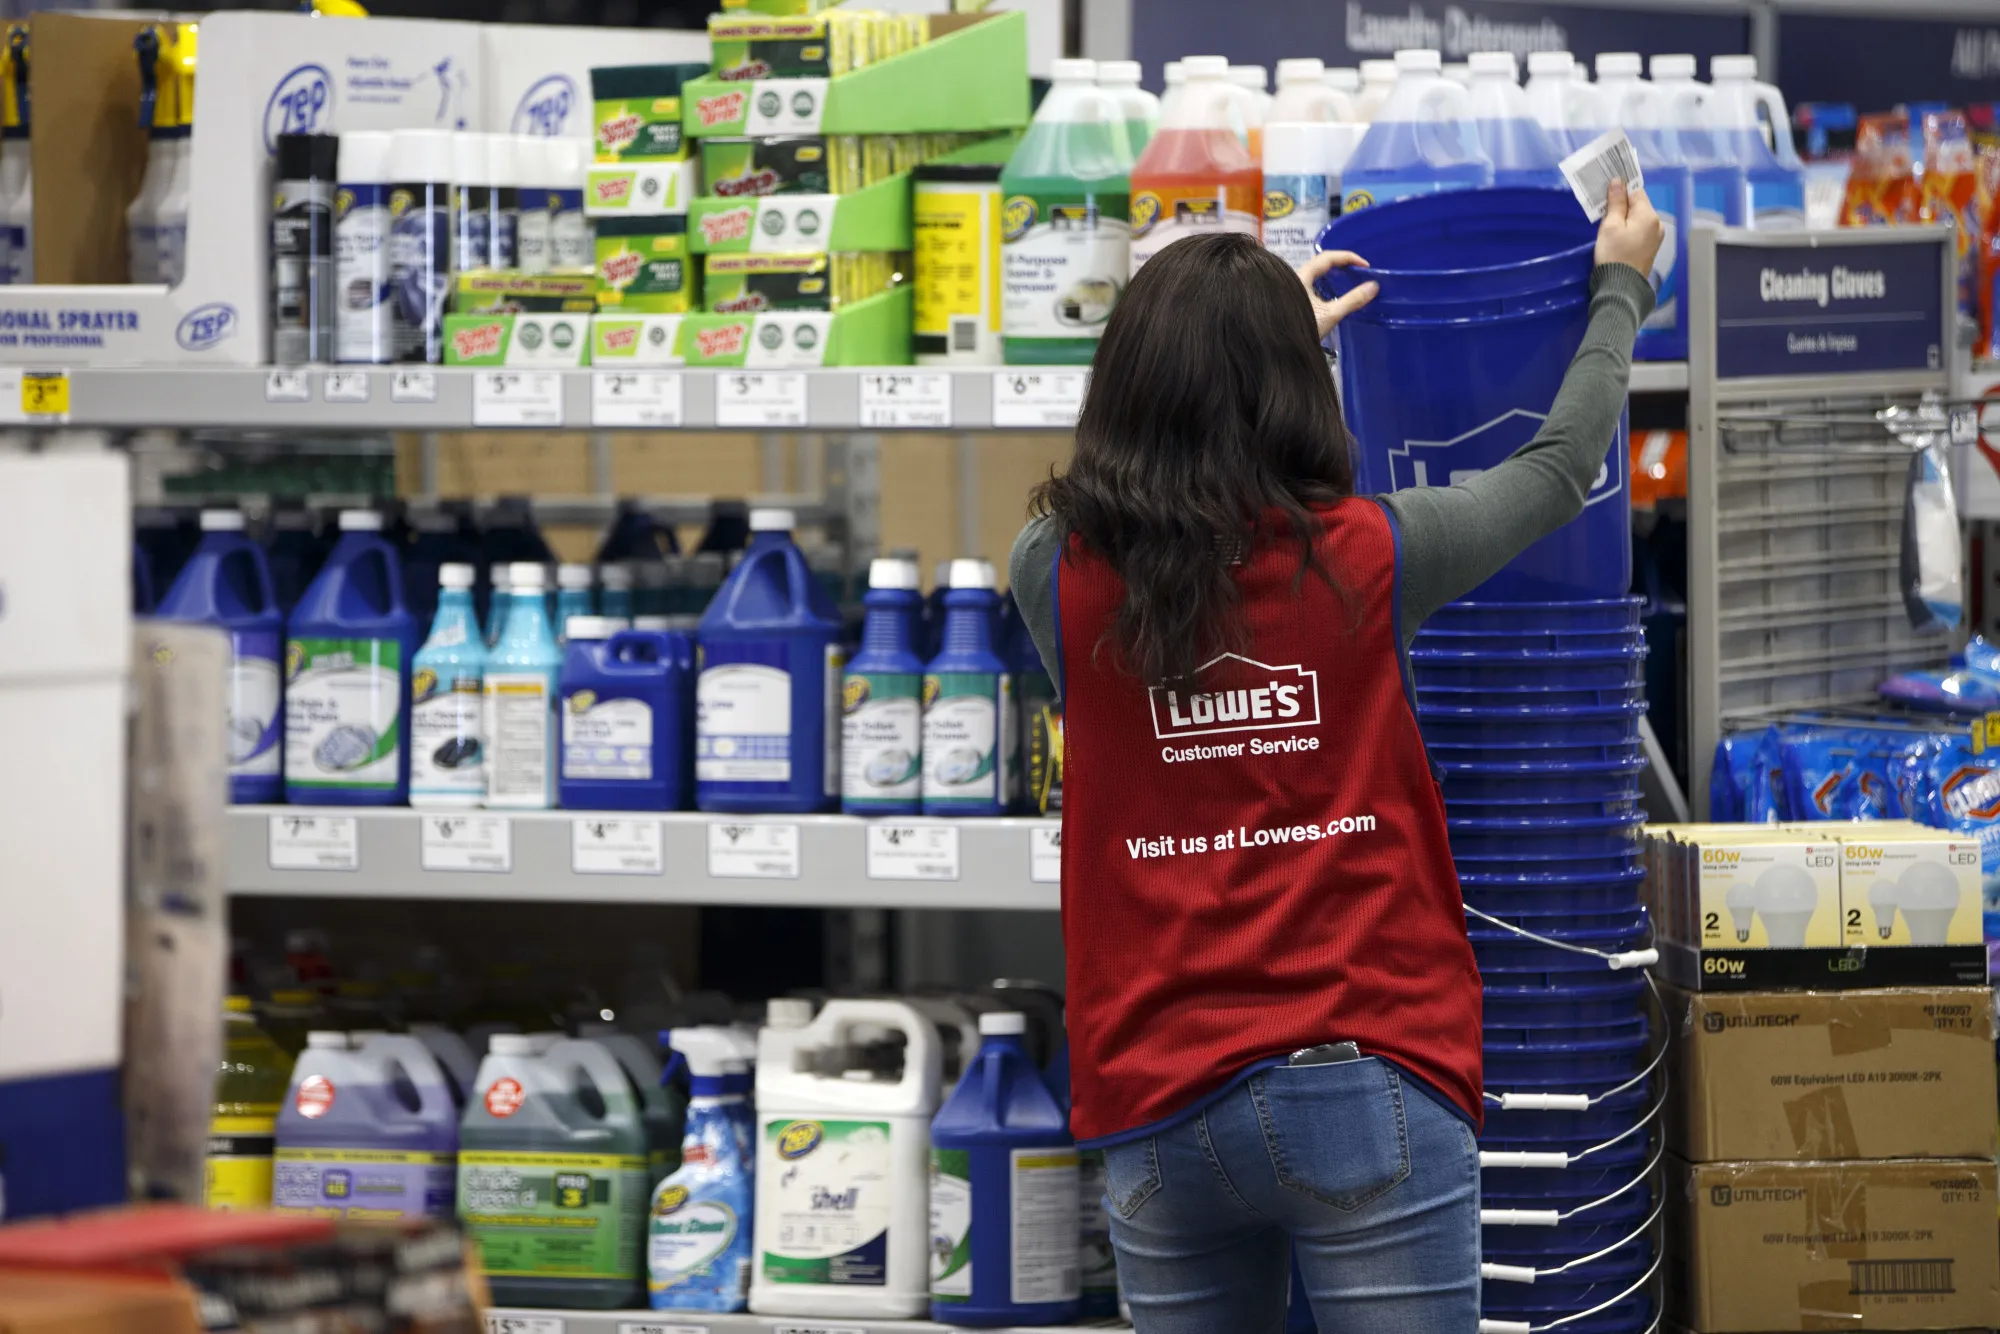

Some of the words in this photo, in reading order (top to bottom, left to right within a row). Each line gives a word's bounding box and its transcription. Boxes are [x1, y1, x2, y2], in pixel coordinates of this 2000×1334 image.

[1760, 266, 1829, 307] Cleaning
[1831, 264, 1885, 299] Gloves
[58, 309, 139, 331] SPRAYER
[189, 311, 232, 342] ZEP
[1162, 743, 1246, 763] Customer
[1250, 735, 1320, 756] Service
[1127, 836, 1175, 860] Visit
[1181, 837, 1208, 855] us
[1213, 830, 1235, 851] at
[1240, 814, 1376, 848] Lowes.com
[1703, 848, 1741, 863] 60w
[1806, 855, 1834, 868] LED
[1845, 845, 1884, 861] 60w
[1949, 852, 1977, 866] LED
[1705, 911, 1720, 931] 2
[1847, 908, 1862, 927] 2
[1703, 957, 1745, 974] 60w
[1828, 957, 1860, 973] LED
[1959, 1017, 1973, 1028] 12
[1794, 1073, 1845, 1088] Equivalent
[1847, 1071, 1866, 1084] LED
[1868, 1070, 1886, 1083] A19
[1967, 1190, 1981, 1202] 12
